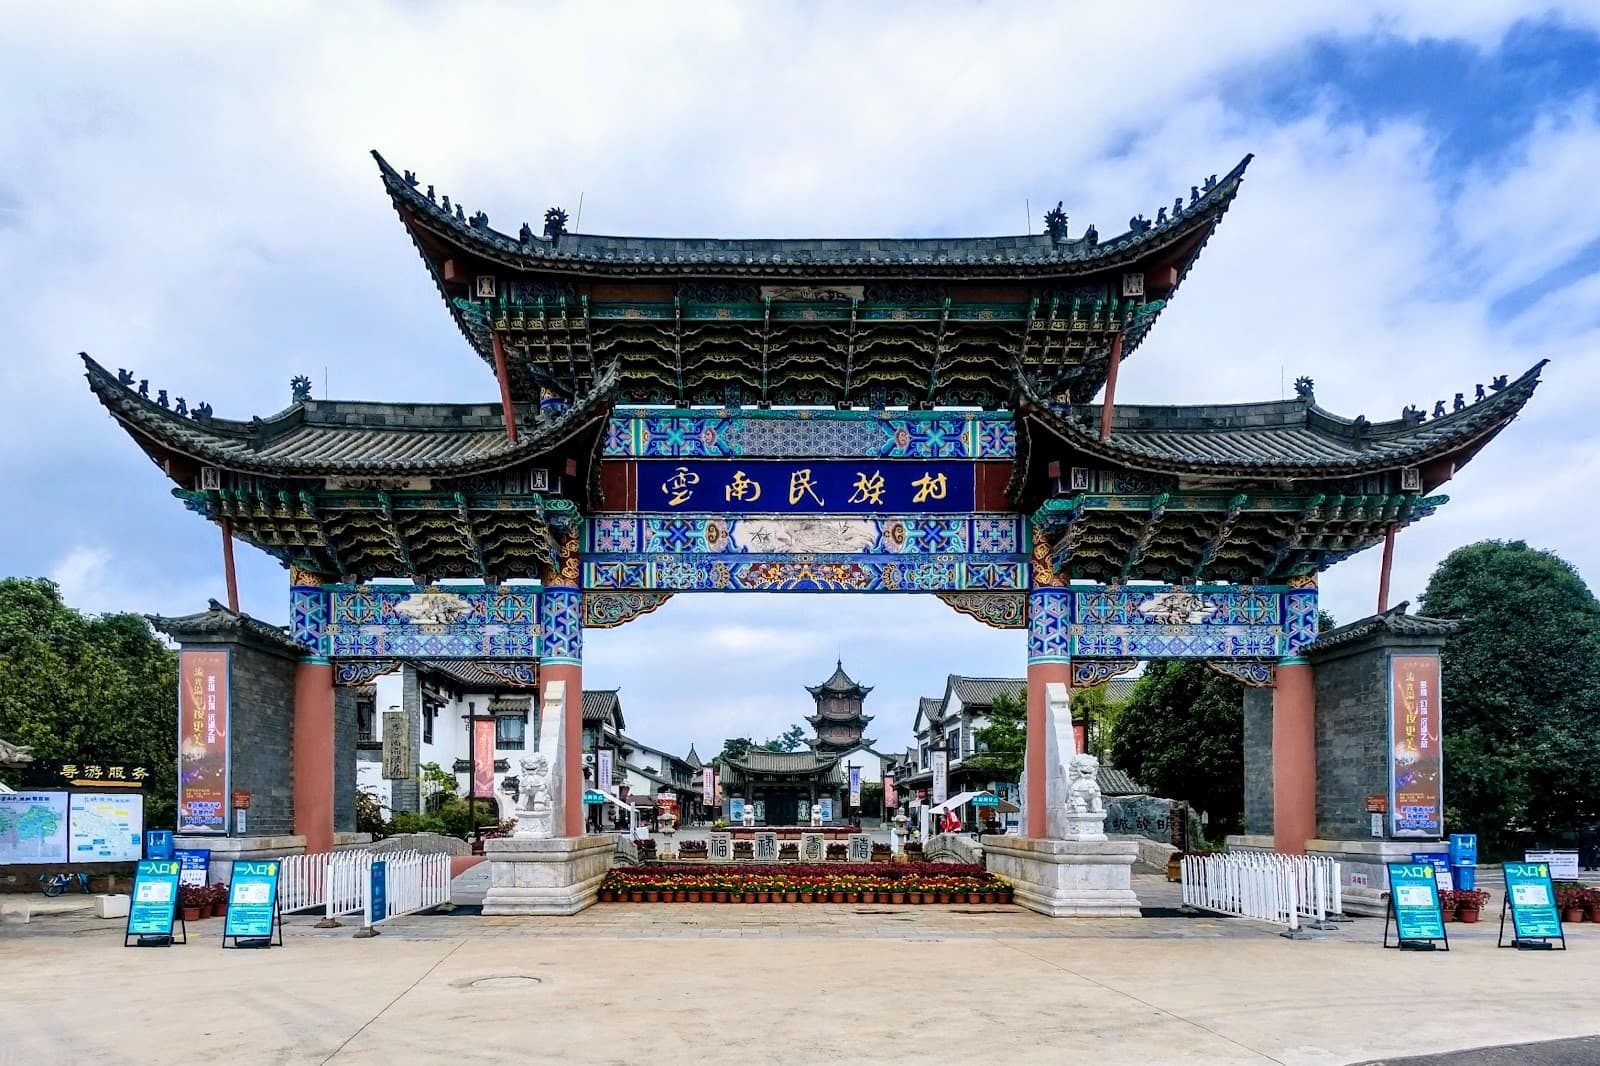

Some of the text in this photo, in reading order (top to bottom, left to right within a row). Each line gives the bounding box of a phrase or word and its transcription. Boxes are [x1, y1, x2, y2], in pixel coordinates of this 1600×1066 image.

[59, 764, 150, 779] 导游服务
[711, 835, 727, 857] 福
[147, 862, 170, 874] 入口
[243, 863, 267, 875] 入口
[1401, 866, 1424, 878] 入口
[1516, 866, 1539, 878] 入口
